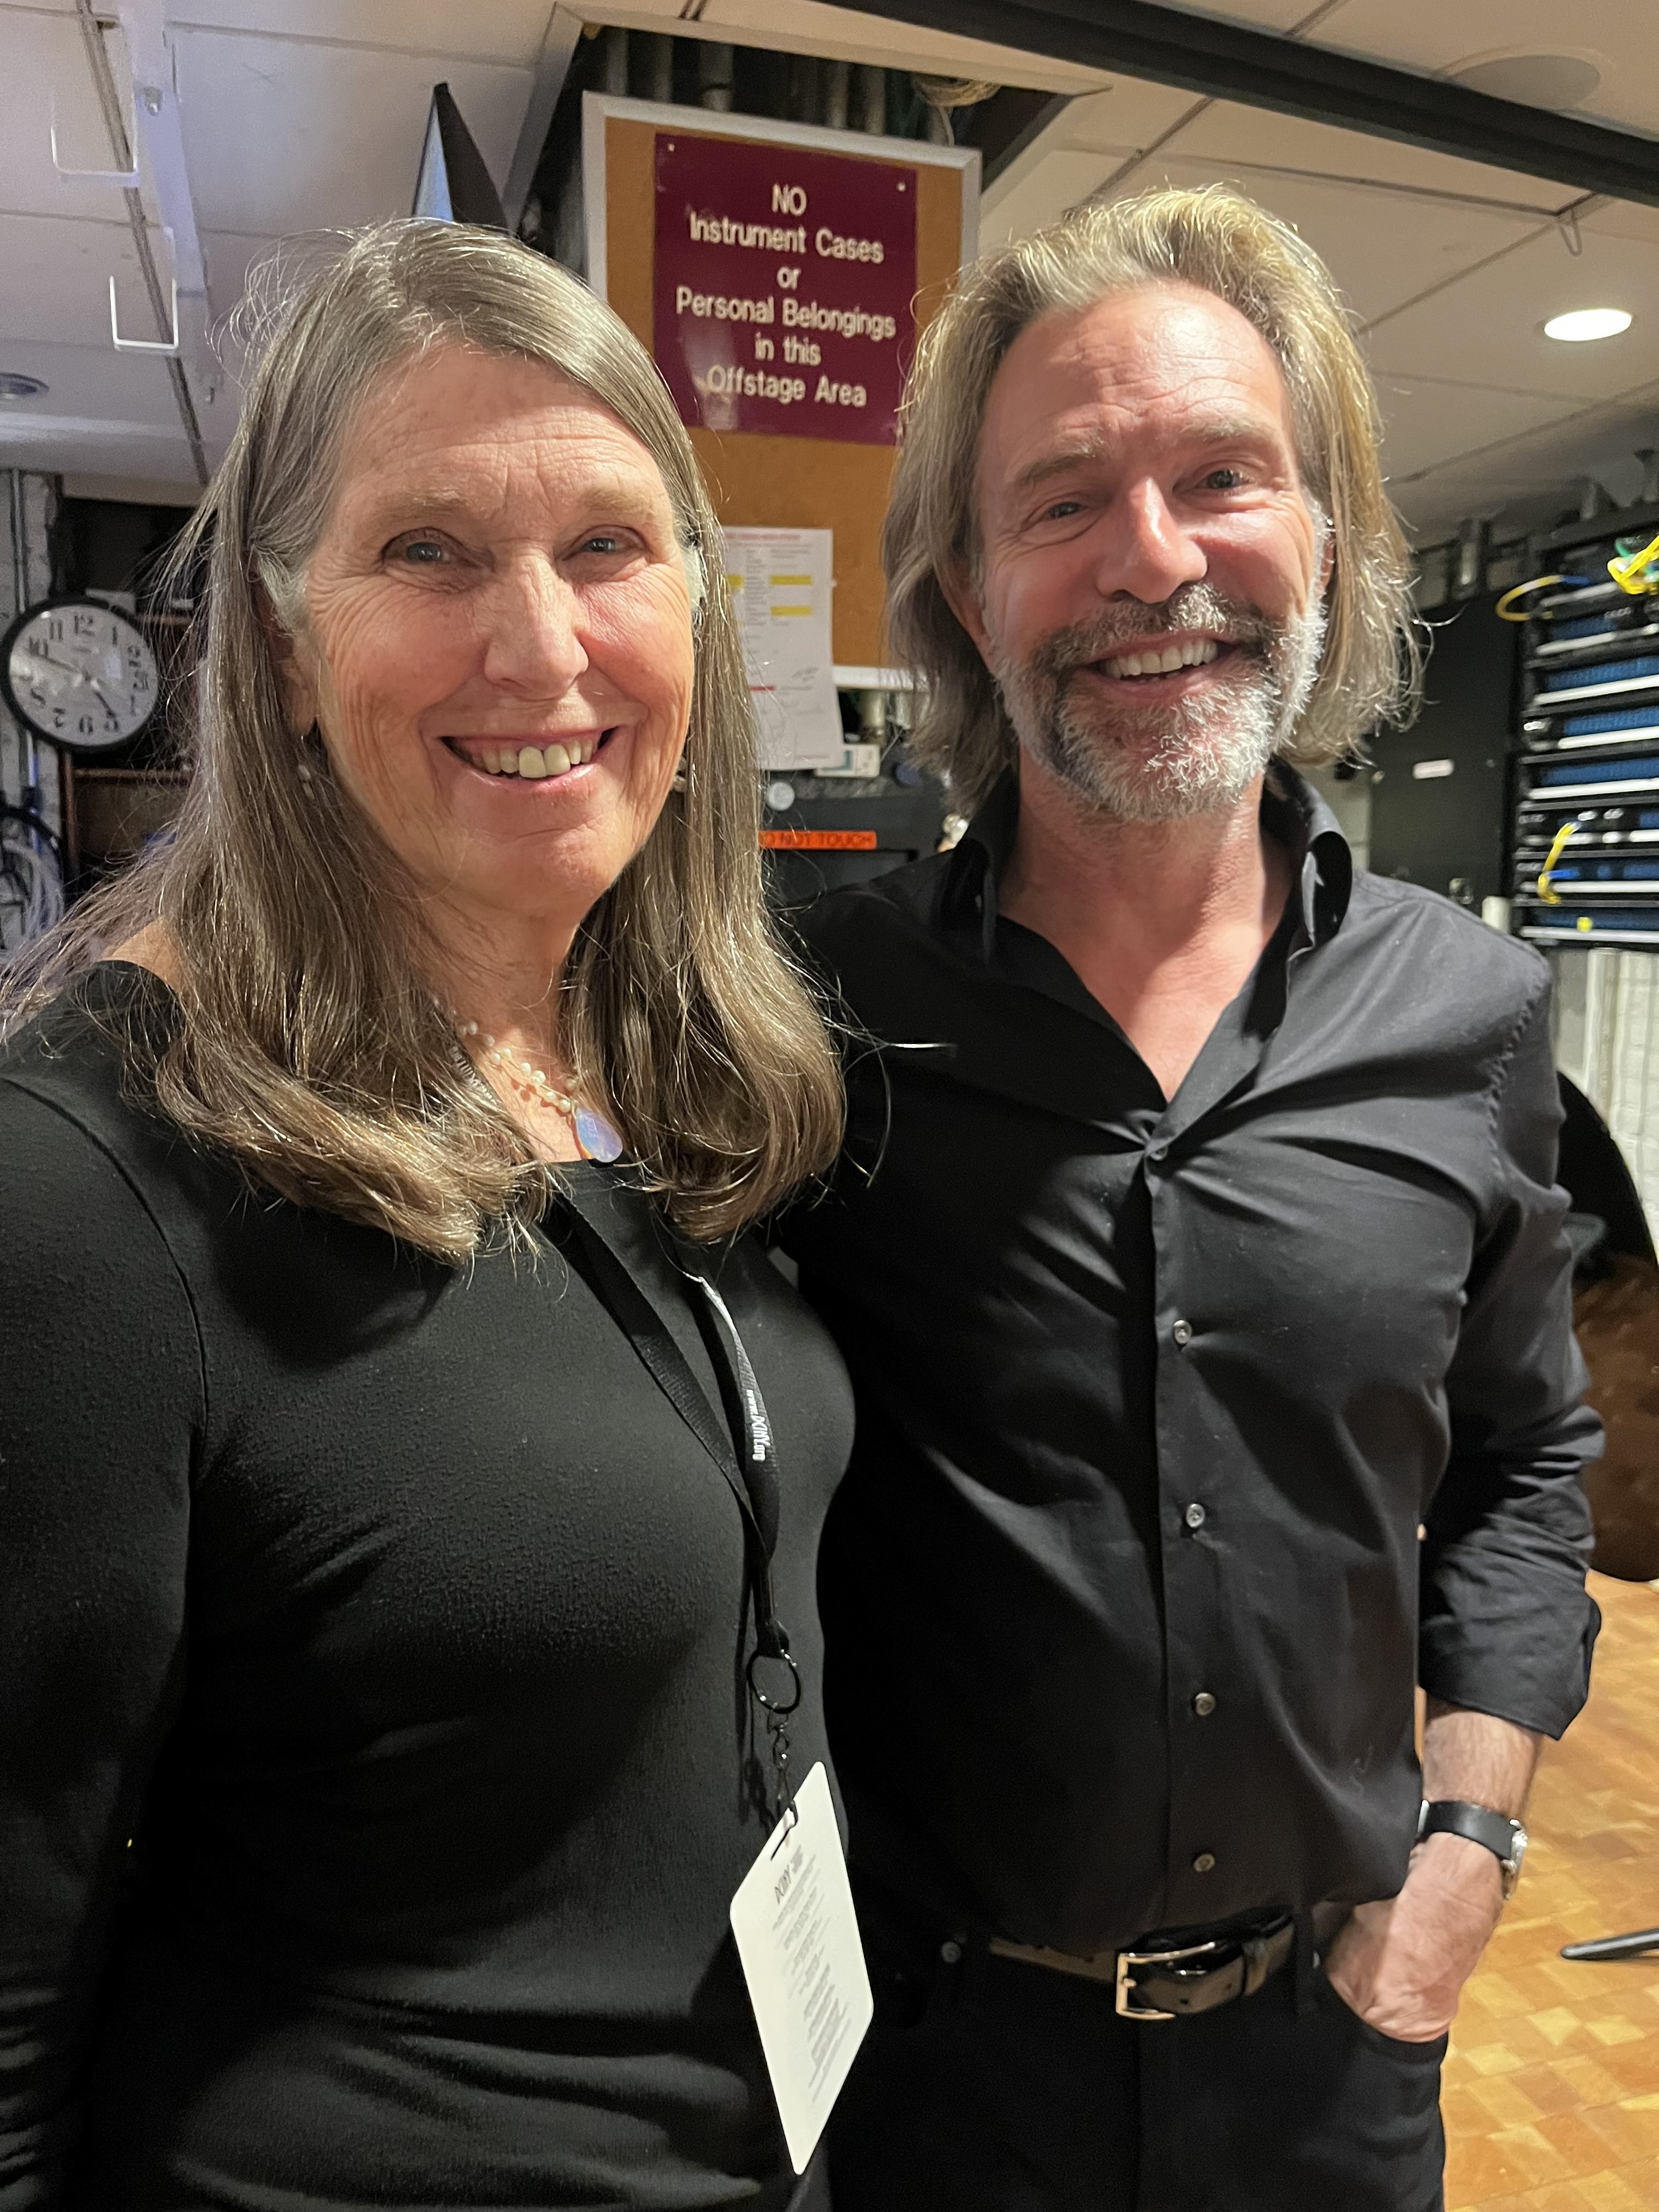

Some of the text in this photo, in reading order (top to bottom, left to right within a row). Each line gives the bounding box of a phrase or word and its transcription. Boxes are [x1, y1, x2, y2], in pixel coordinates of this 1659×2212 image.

[772, 183, 807, 216] NO
[689, 213, 884, 263] Instrument Cases
[777, 266, 802, 289] or
[676, 286, 897, 341] Personal Belongings
[755, 332, 822, 366] in this
[707, 364, 867, 407] Offstage Area
[74, 614, 96, 636] 12
